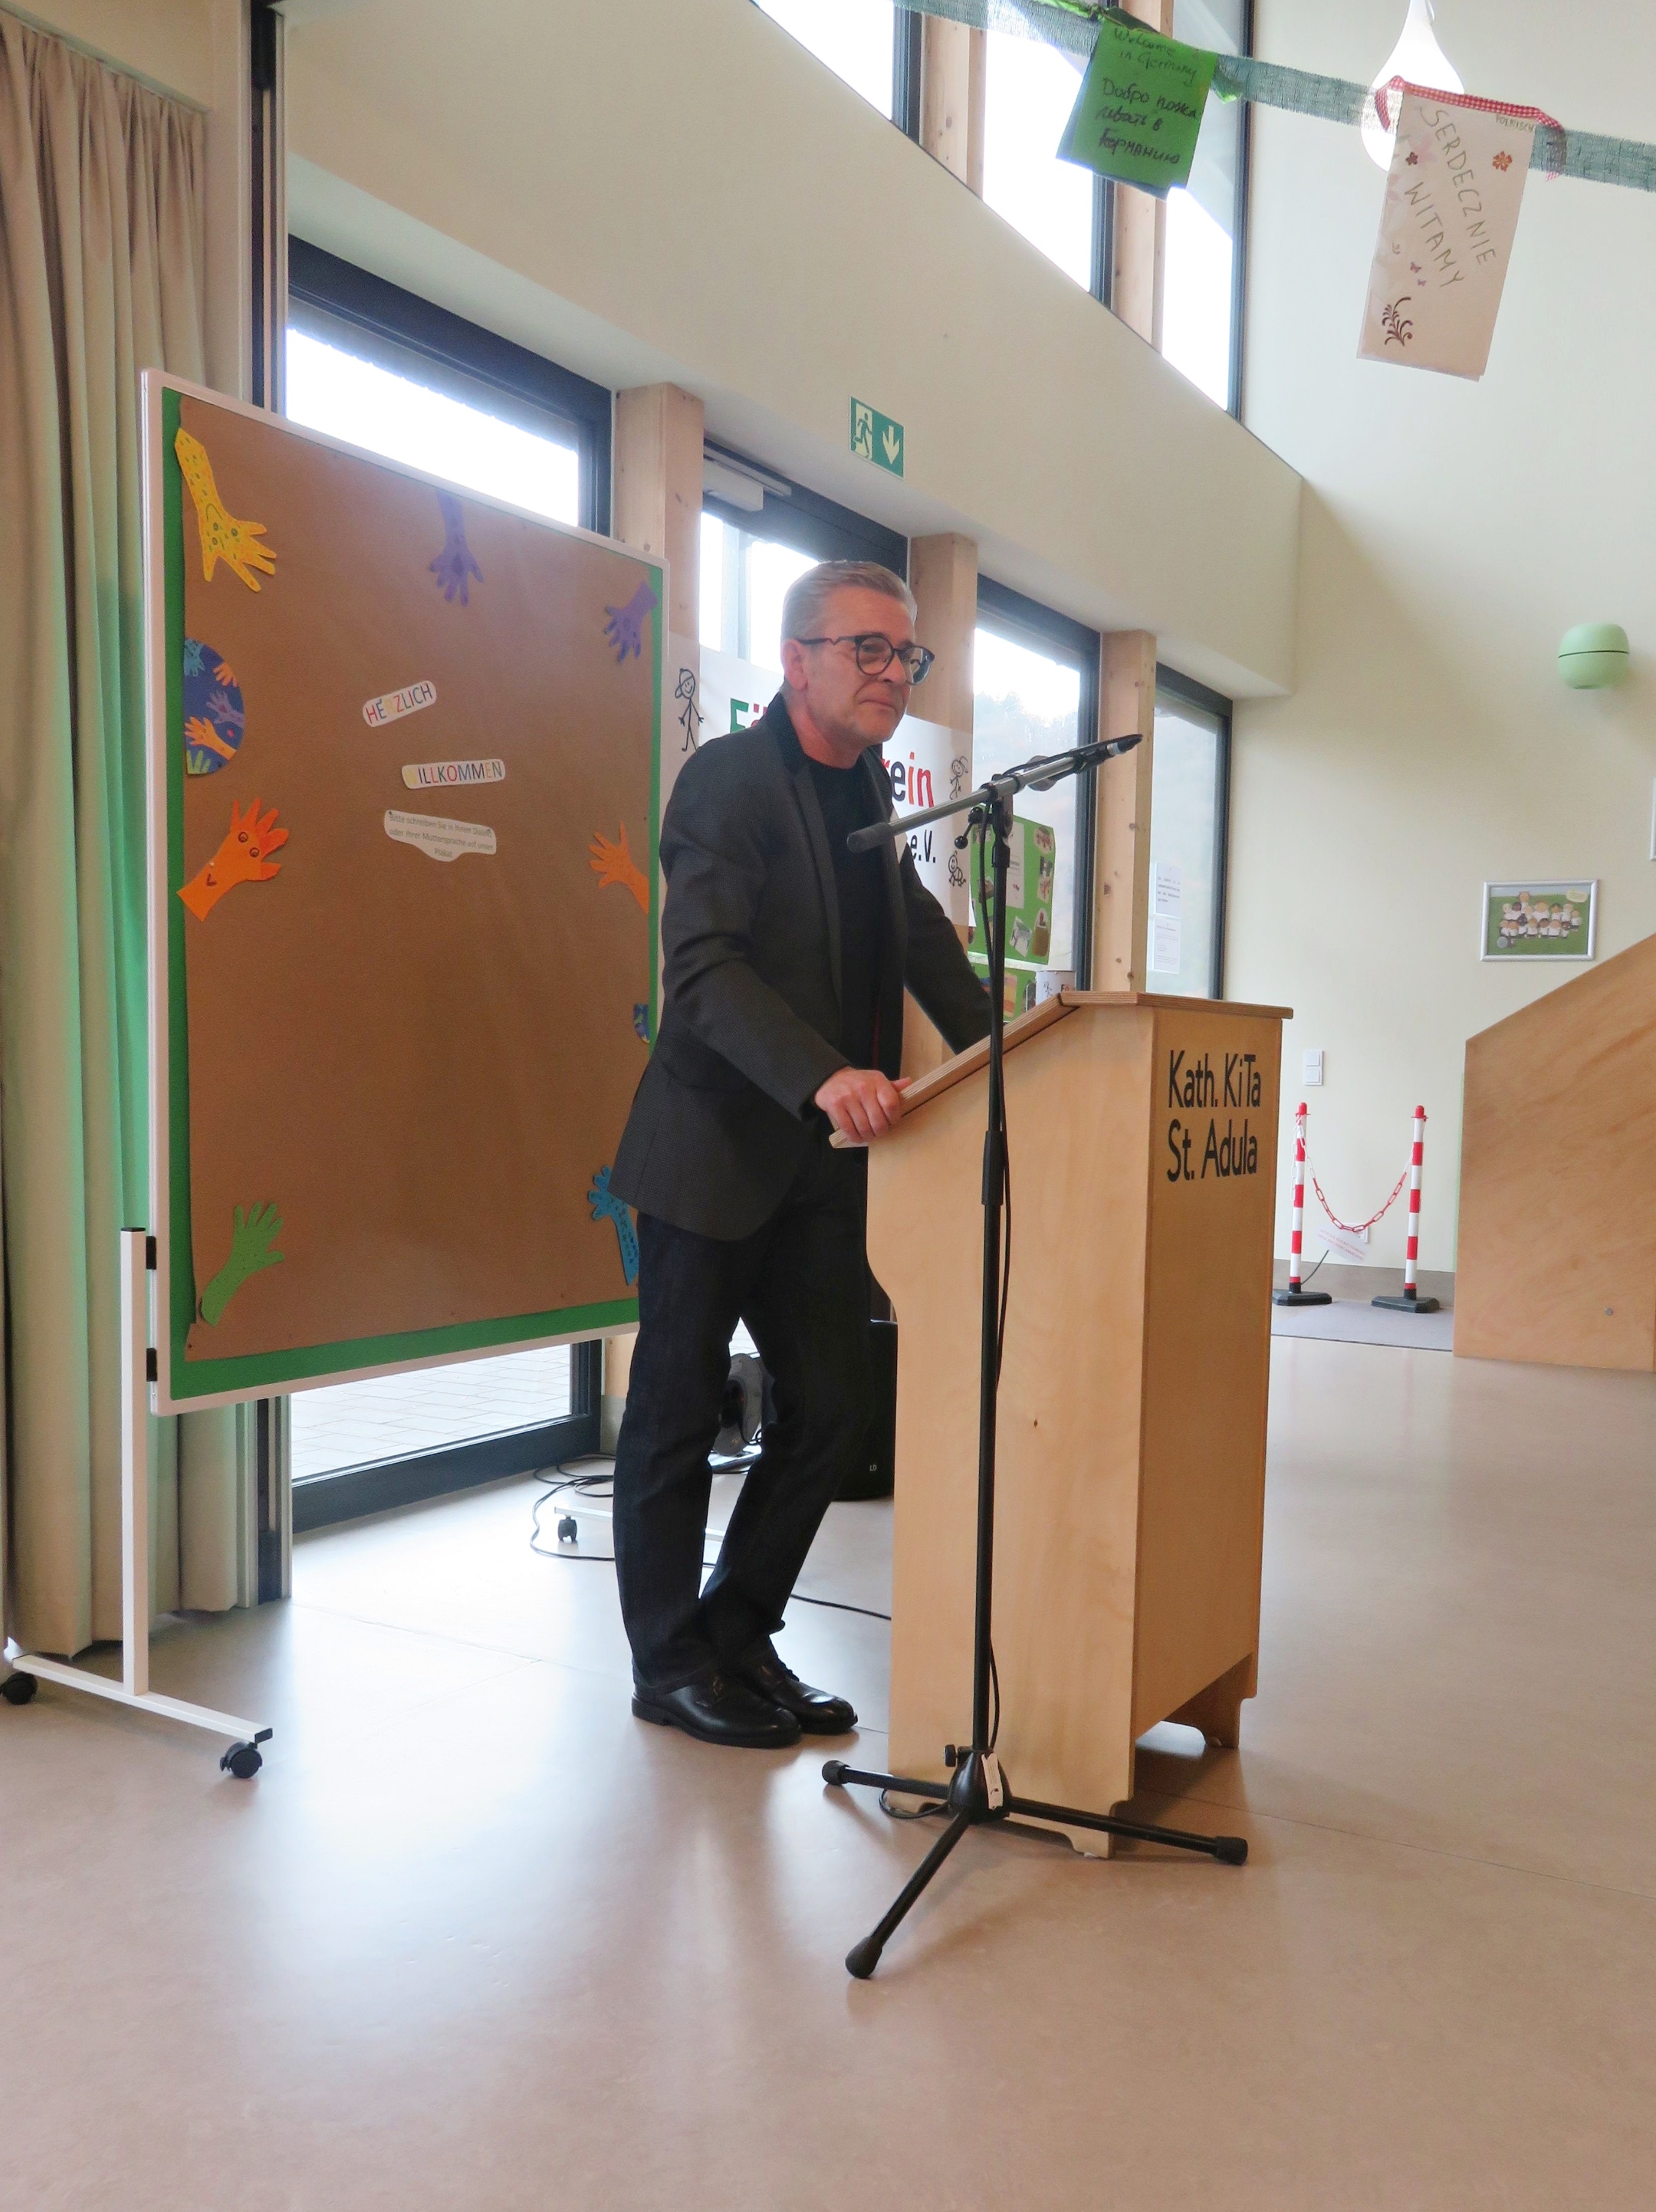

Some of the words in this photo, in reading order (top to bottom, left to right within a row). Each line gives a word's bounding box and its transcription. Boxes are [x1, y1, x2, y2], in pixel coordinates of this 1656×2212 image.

[1119, 51, 1132, 61] in
[1420, 106, 1497, 266] SERDECZNIE
[1405, 181, 1465, 288] WITAMY
[366, 682, 434, 725] HERZLICH
[910, 829, 936, 863] e.V.
[1168, 1050, 1218, 1108] Kath.
[1224, 1053, 1261, 1108] KiTa
[1167, 1119, 1194, 1182] St.
[1201, 1119, 1257, 1179] Adula
